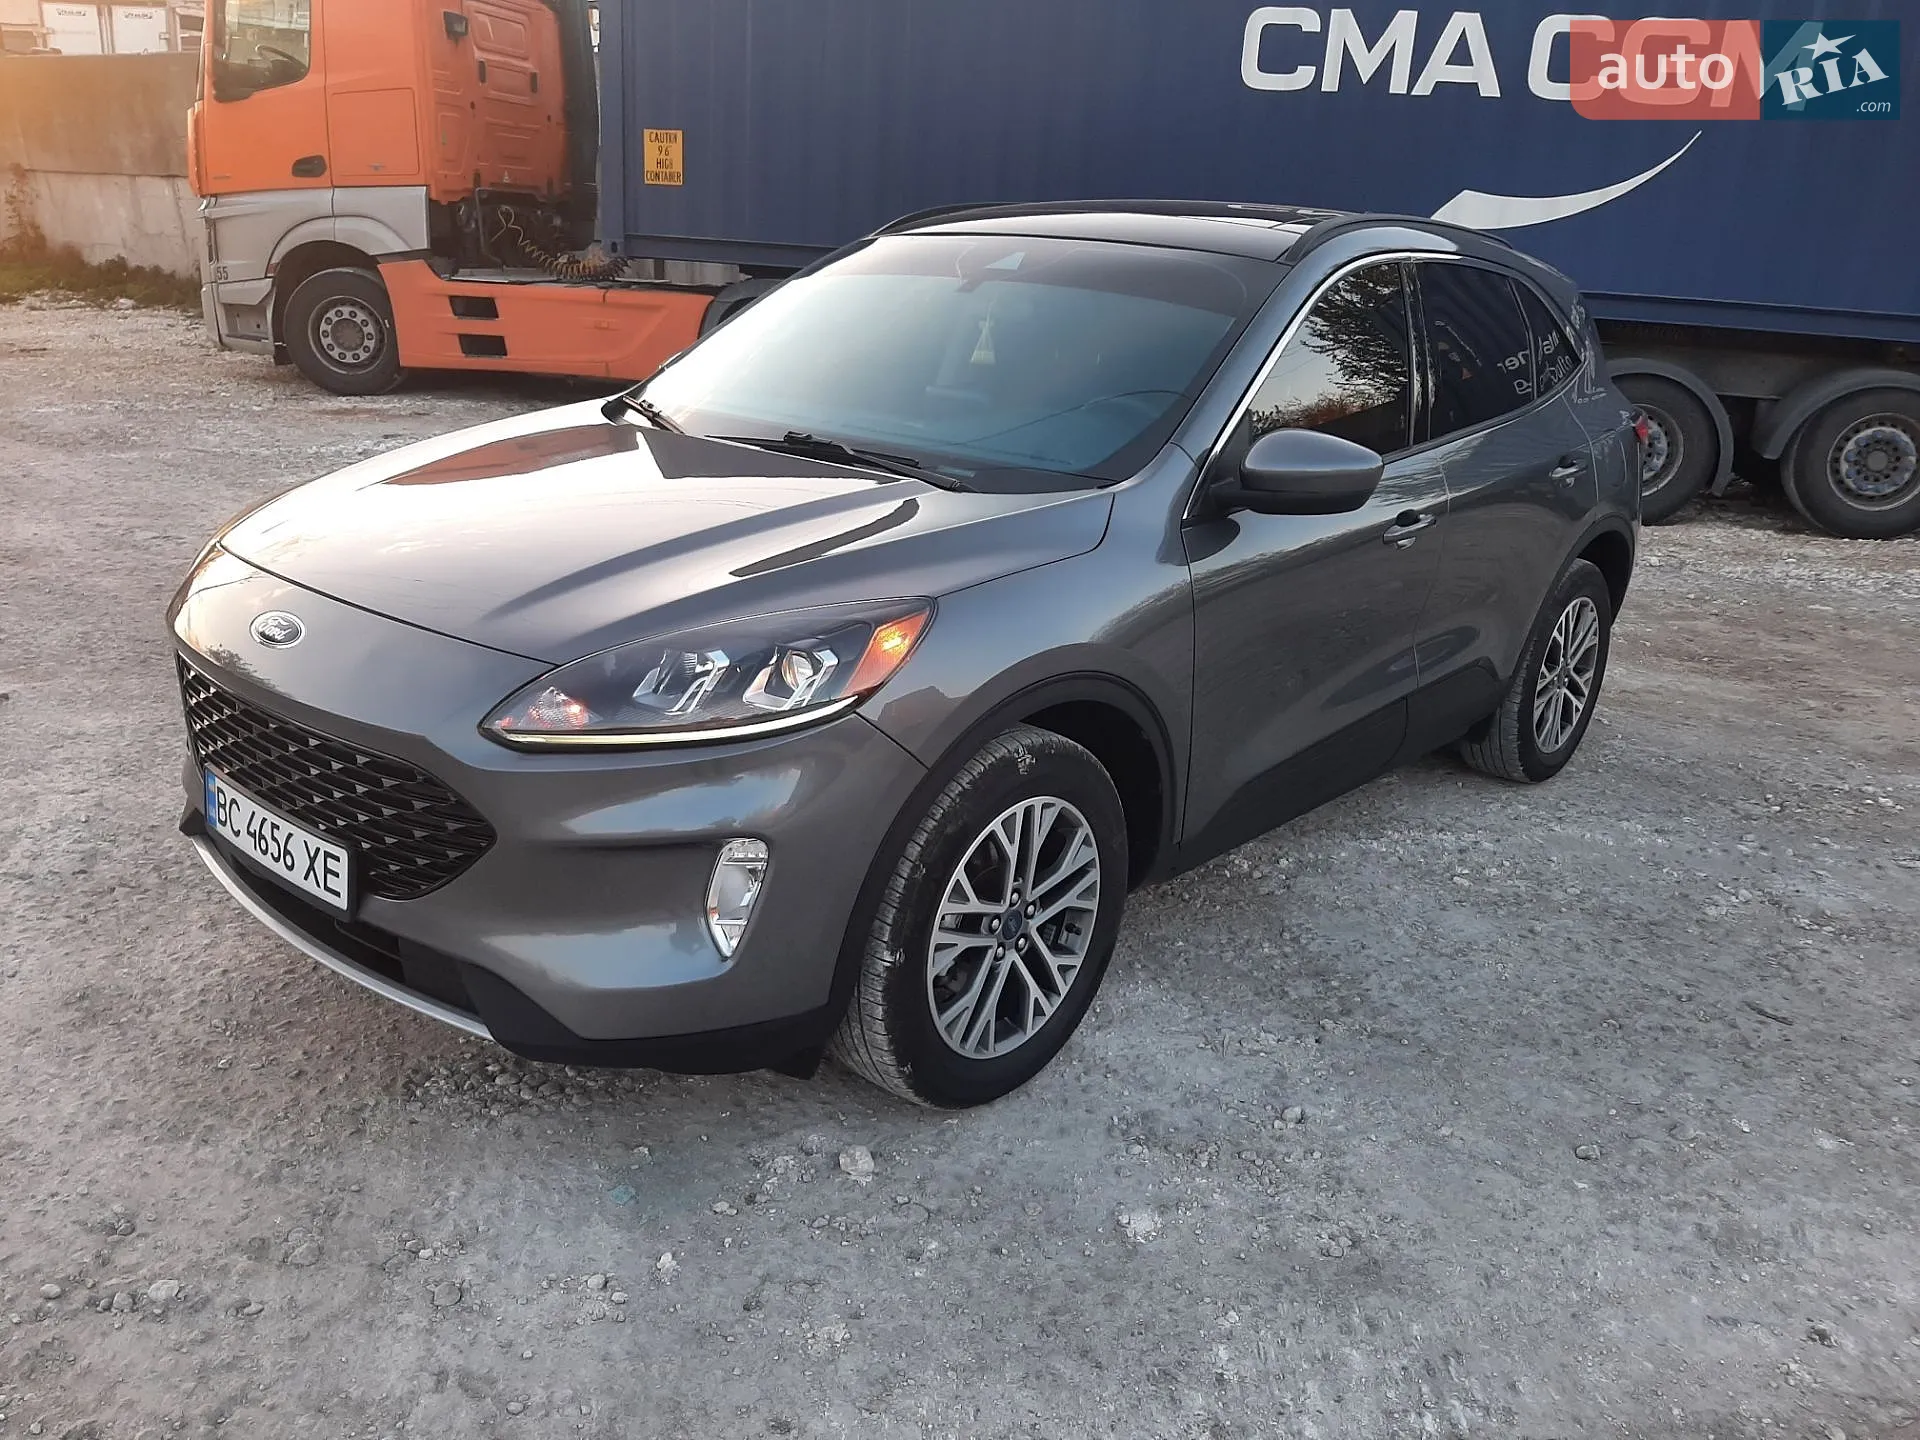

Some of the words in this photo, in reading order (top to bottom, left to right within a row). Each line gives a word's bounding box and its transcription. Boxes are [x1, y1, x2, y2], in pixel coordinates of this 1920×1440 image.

[1241, 6, 1501, 97] CMA
[1527, 14, 1823, 112] CGM
[216, 786, 241, 838] BC
[246, 810, 296, 872] 4656
[303, 839, 342, 899] XE
